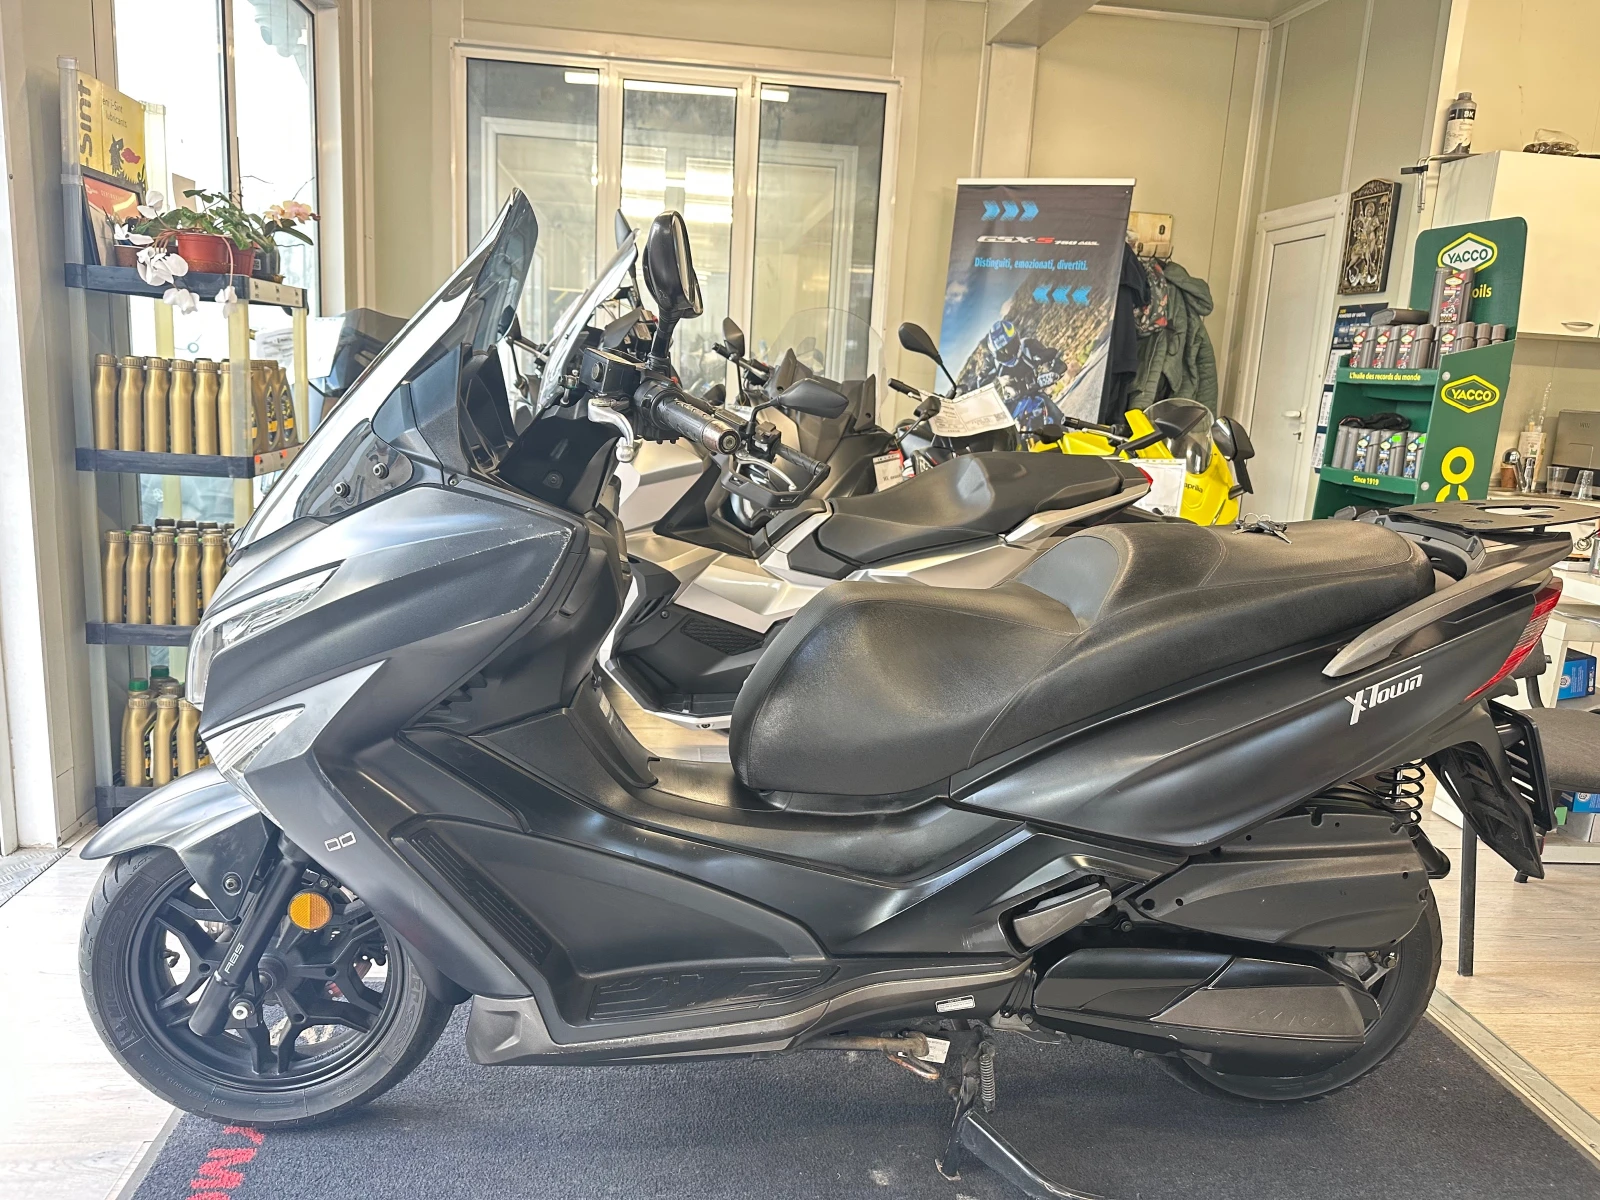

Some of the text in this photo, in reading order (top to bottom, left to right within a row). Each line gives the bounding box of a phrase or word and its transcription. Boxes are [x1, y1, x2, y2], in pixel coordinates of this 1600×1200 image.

[106, 110, 128, 128] lubricants
[1447, 248, 1488, 264] YACCO
[974, 257, 1089, 271] Distinguiti, emozionati, divertiti.
[1471, 284, 1493, 298] oils
[1349, 371, 1421, 381] L'huile des records du monde
[1451, 388, 1492, 401] YACCO
[1353, 475, 1366, 485] Since
[224, 942, 245, 974] ABS
